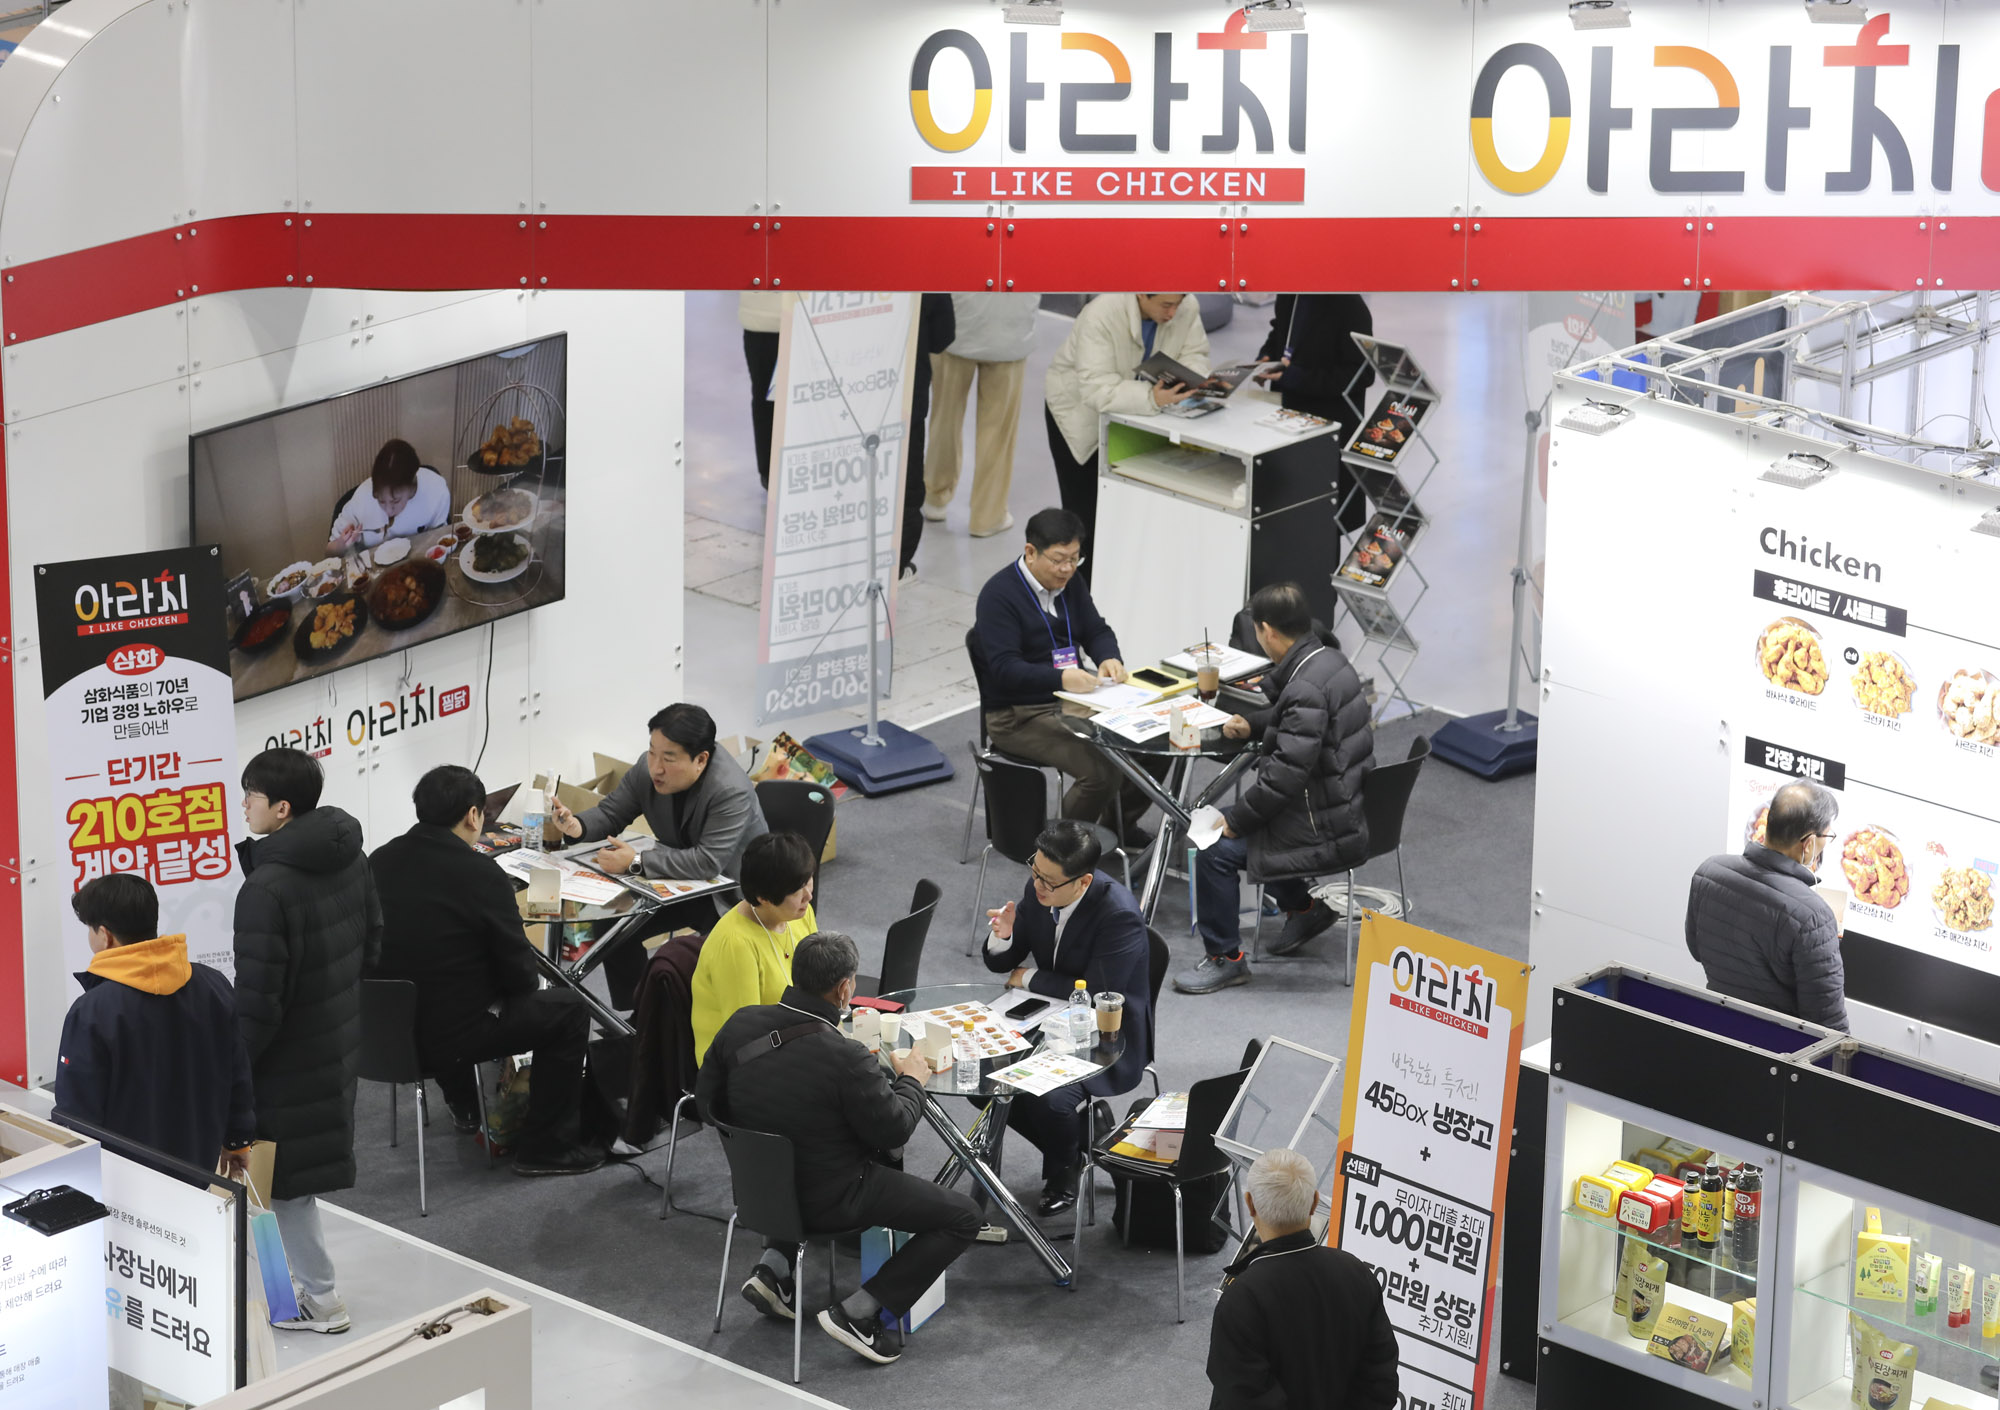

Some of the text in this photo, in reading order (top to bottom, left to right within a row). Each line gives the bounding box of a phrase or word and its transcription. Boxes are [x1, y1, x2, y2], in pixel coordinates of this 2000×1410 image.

[910, 8, 1308, 154] 아라치
[1470, 13, 1960, 194] 아라치
[952, 171, 1267, 197] I LIKE CHICKEN
[1759, 526, 1881, 583] Chicken
[75, 568, 188, 622] 아라치
[1773, 579, 1831, 612] 후라이드
[89, 616, 178, 634] I LIKE CHICKEN
[113, 648, 159, 671] 삼화
[84, 677, 189, 705] 삼화식품의 70년
[1789, 695, 1817, 711] 후라이드
[81, 696, 199, 724] 기업 경영 노하우로
[346, 682, 434, 746] 아라치
[113, 719, 169, 740] 만들어낸
[107, 751, 182, 786] 단기간
[1765, 746, 1825, 782] 간장 치킨
[1979, 745, 1994, 758] 치킨
[69, 786, 224, 848] 210호점
[156, 834, 227, 882] 달성
[1973, 940, 1988, 951] 치킨
[1393, 951, 1493, 1023] 아라치
[1399, 998, 1479, 1034] I LIKE CHICKEN
[1391, 1052, 1437, 1087] 박람회
[1364, 1080, 1494, 1151] 45Box 냉장고
[1395, 1188, 1485, 1237] 무이자 대출 최대
[164, 1230, 178, 1243] 모든
[1354, 1192, 1482, 1276] 1,000만원
[48, 1256, 68, 1272] 따라
[35, 1279, 63, 1298] 드려요
[1434, 1290, 1476, 1329] 상당
[151, 1308, 211, 1358] 드려요
[1418, 1314, 1473, 1349] 추가 지원!
[6, 1373, 25, 1388] 드려요
